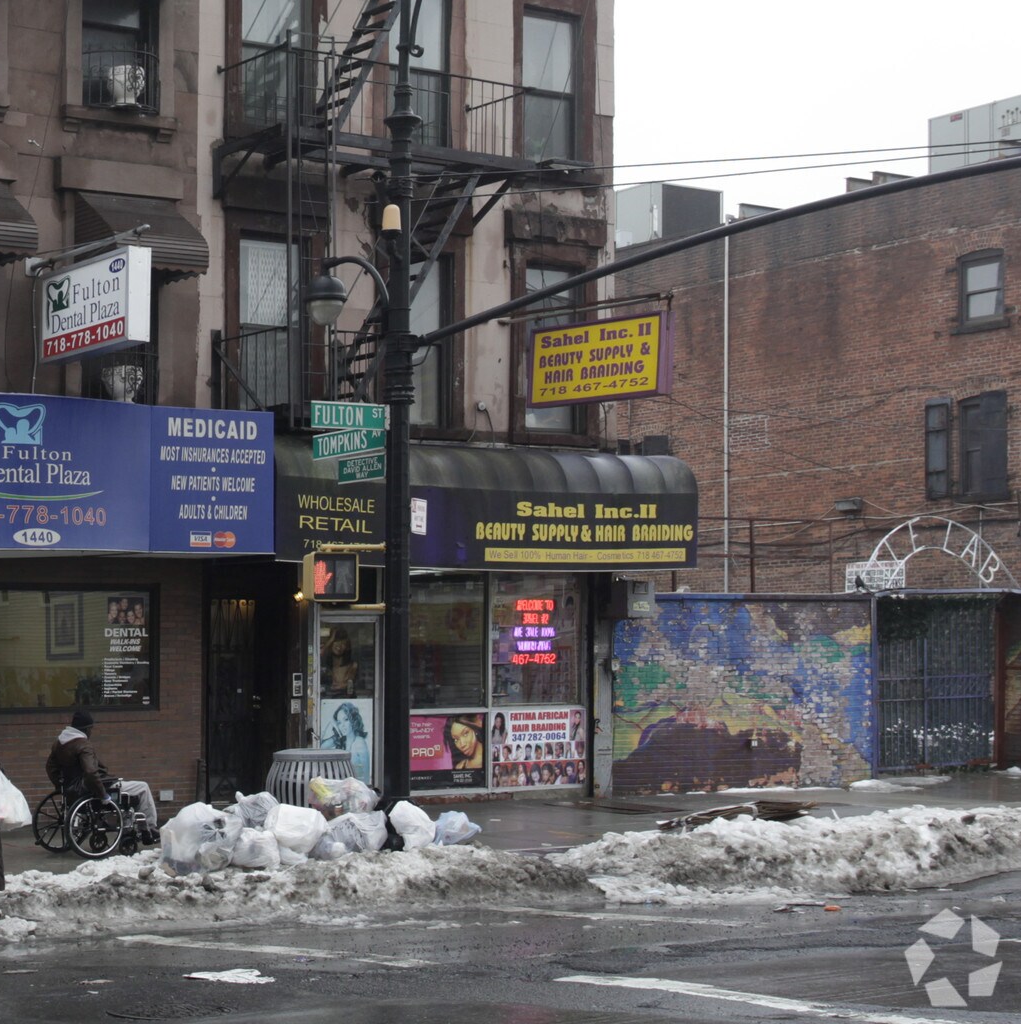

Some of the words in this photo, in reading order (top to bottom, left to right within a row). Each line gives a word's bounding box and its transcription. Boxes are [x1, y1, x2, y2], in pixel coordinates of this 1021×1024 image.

[73, 276, 120, 304] Fulton
[51, 305, 86, 334] Dental
[90, 301, 120, 322] Plaza
[46, 321, 124, 355] 718-778-1040
[540, 331, 589, 349] Sahel
[600, 328, 633, 341] Inc.
[638, 322, 651, 336] II
[539, 351, 583, 368] BEAUTY
[589, 344, 633, 362] SUPPLY
[640, 342, 650, 355] &
[544, 369, 573, 384] HAIR
[580, 360, 644, 380] BRAIDING
[539, 386, 567, 396] 718
[572, 377, 649, 393] 467-4752
[314, 405, 364, 426] FULTON
[372, 408, 383, 418] ST
[168, 417, 257, 440] MEDICAID
[317, 430, 367, 456] TOMPKINS
[2, 445, 72, 461] Fulton
[160, 445, 180, 461] MOST
[181, 446, 229, 463] INSHURANCES
[230, 448, 266, 464] ACCEPTED
[346, 457, 378, 467] DETECTIVE
[46, 463, 91, 485] Plaza
[343, 466, 360, 474] DAVID
[362, 463, 382, 471] ALLEN
[171, 475, 187, 490] NEW
[188, 475, 220, 491] PATIENTS
[222, 477, 255, 492] WELCOME
[179, 504, 205, 519] ADULTS
[207, 505, 211, 519] &
[214, 505, 248, 520] CHILDREN
[298, 494, 375, 514] WHOLESALE
[516, 501, 585, 518] Sahel
[299, 515, 373, 534] RETAIL
[475, 522, 526, 541] BEAUTY
[531, 524, 579, 542] SUPPLY
[580, 525, 592, 542] &
[595, 524, 625, 541] HAIR
[632, 524, 693, 541] BRAIDING
[22, 531, 53, 543] 1440
[489, 551, 502, 559] We
[503, 550, 518, 559] Sell
[520, 551, 541, 559] 100%
[545, 552, 571, 560] Human
[573, 552, 588, 560] Hair
[597, 552, 634, 560] Cosmetics
[636, 551, 650, 559] 718
[651, 551, 684, 559] 467-4752
[104, 628, 149, 637] DENTAL
[512, 653, 556, 664] 467-4752
[510, 712, 537, 721] FATIMA
[537, 711, 568, 720] AFRICAN
[512, 724, 530, 732] HAIR
[531, 722, 566, 732] BRAIDING
[512, 733, 526, 742] 347
[527, 732, 566, 741] 282-0064
